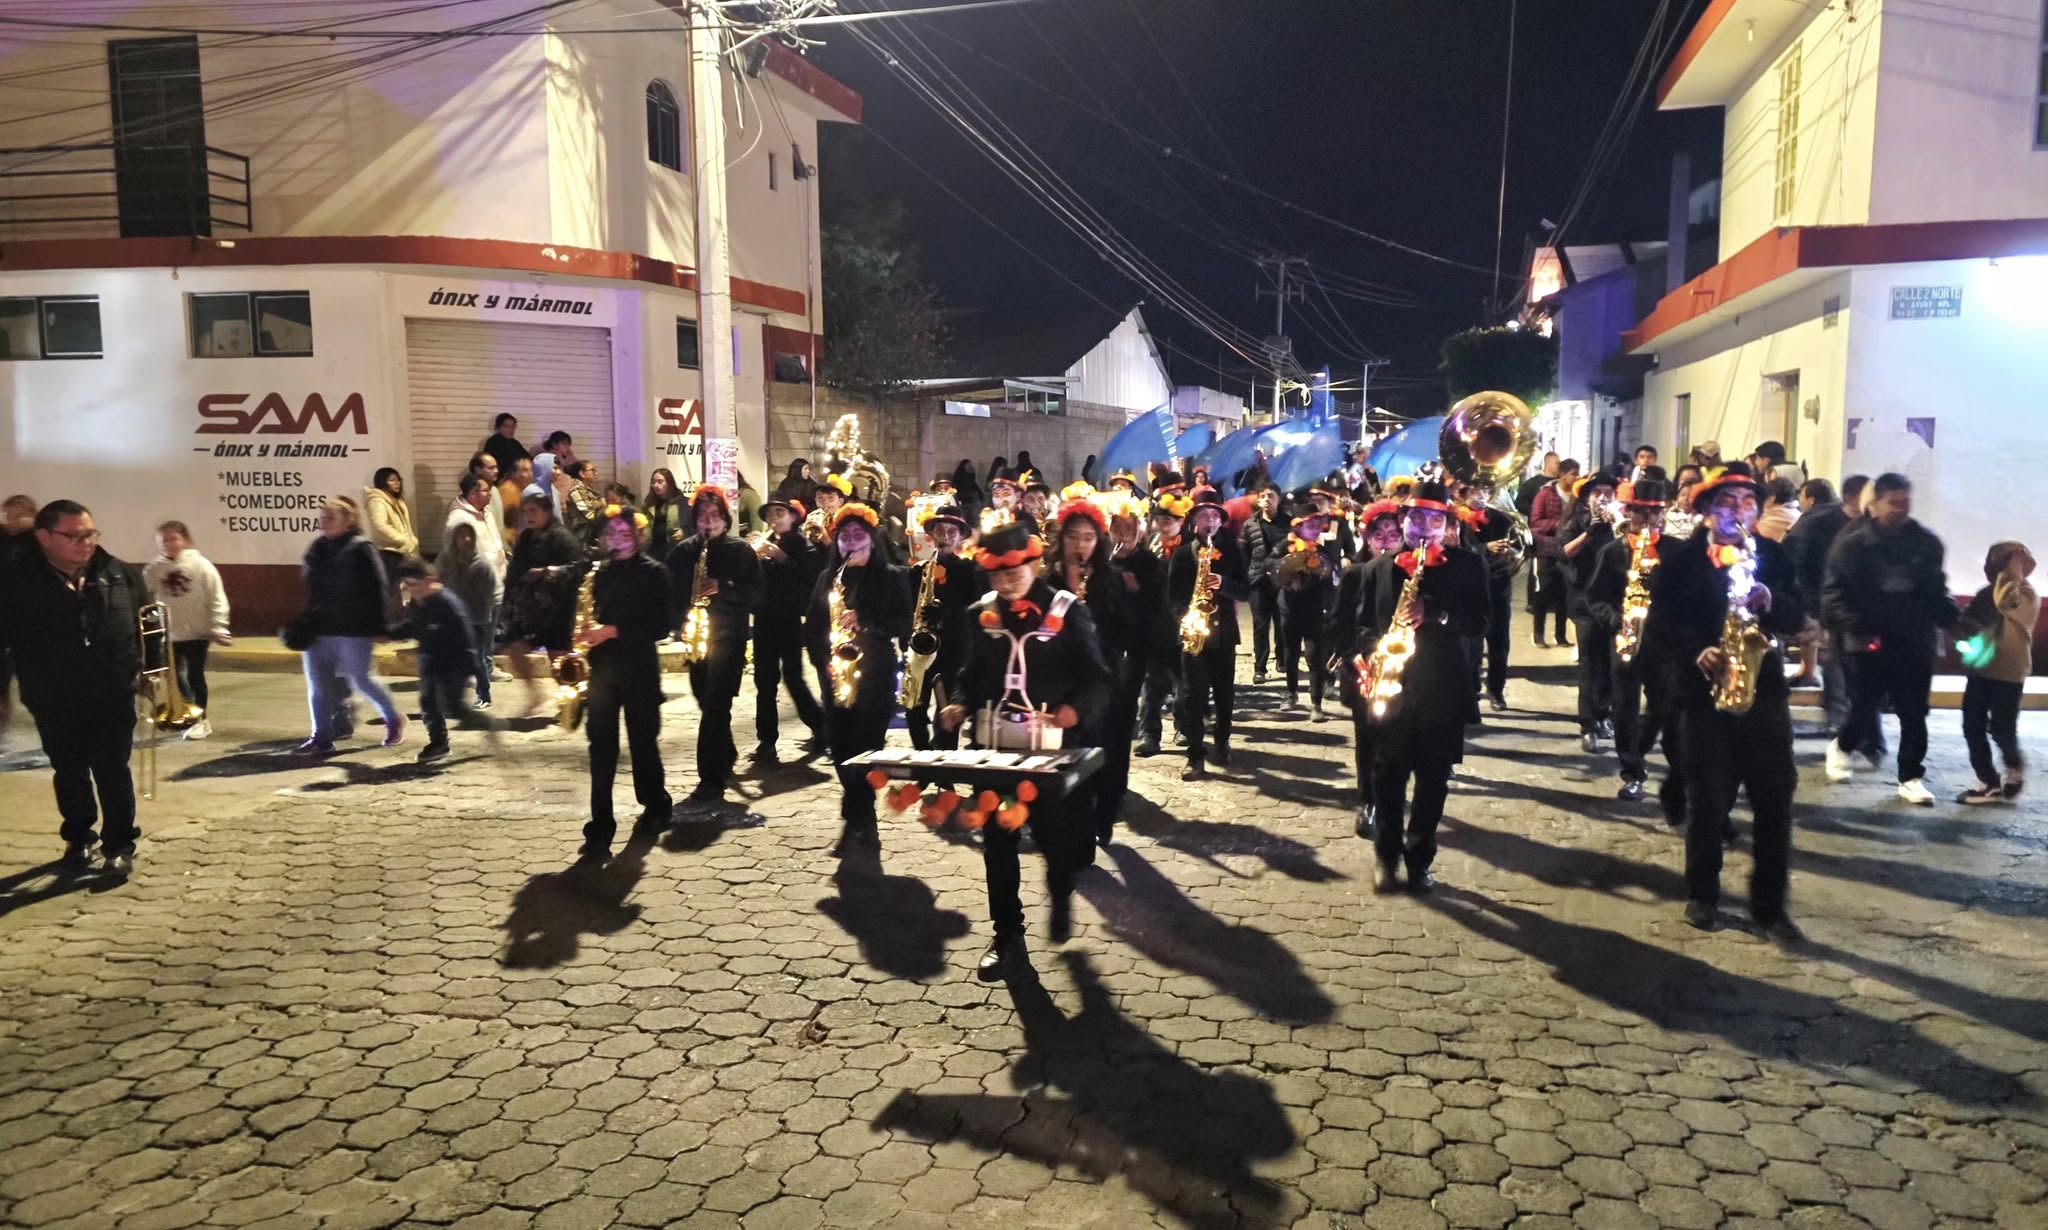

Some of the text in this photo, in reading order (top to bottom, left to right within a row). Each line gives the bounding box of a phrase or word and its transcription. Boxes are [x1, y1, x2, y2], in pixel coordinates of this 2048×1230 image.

[1894, 287, 1922, 300] CALLE
[1931, 287, 1961, 300] NORTE
[194, 391, 368, 435] SAM
[656, 398, 703, 435] SA
